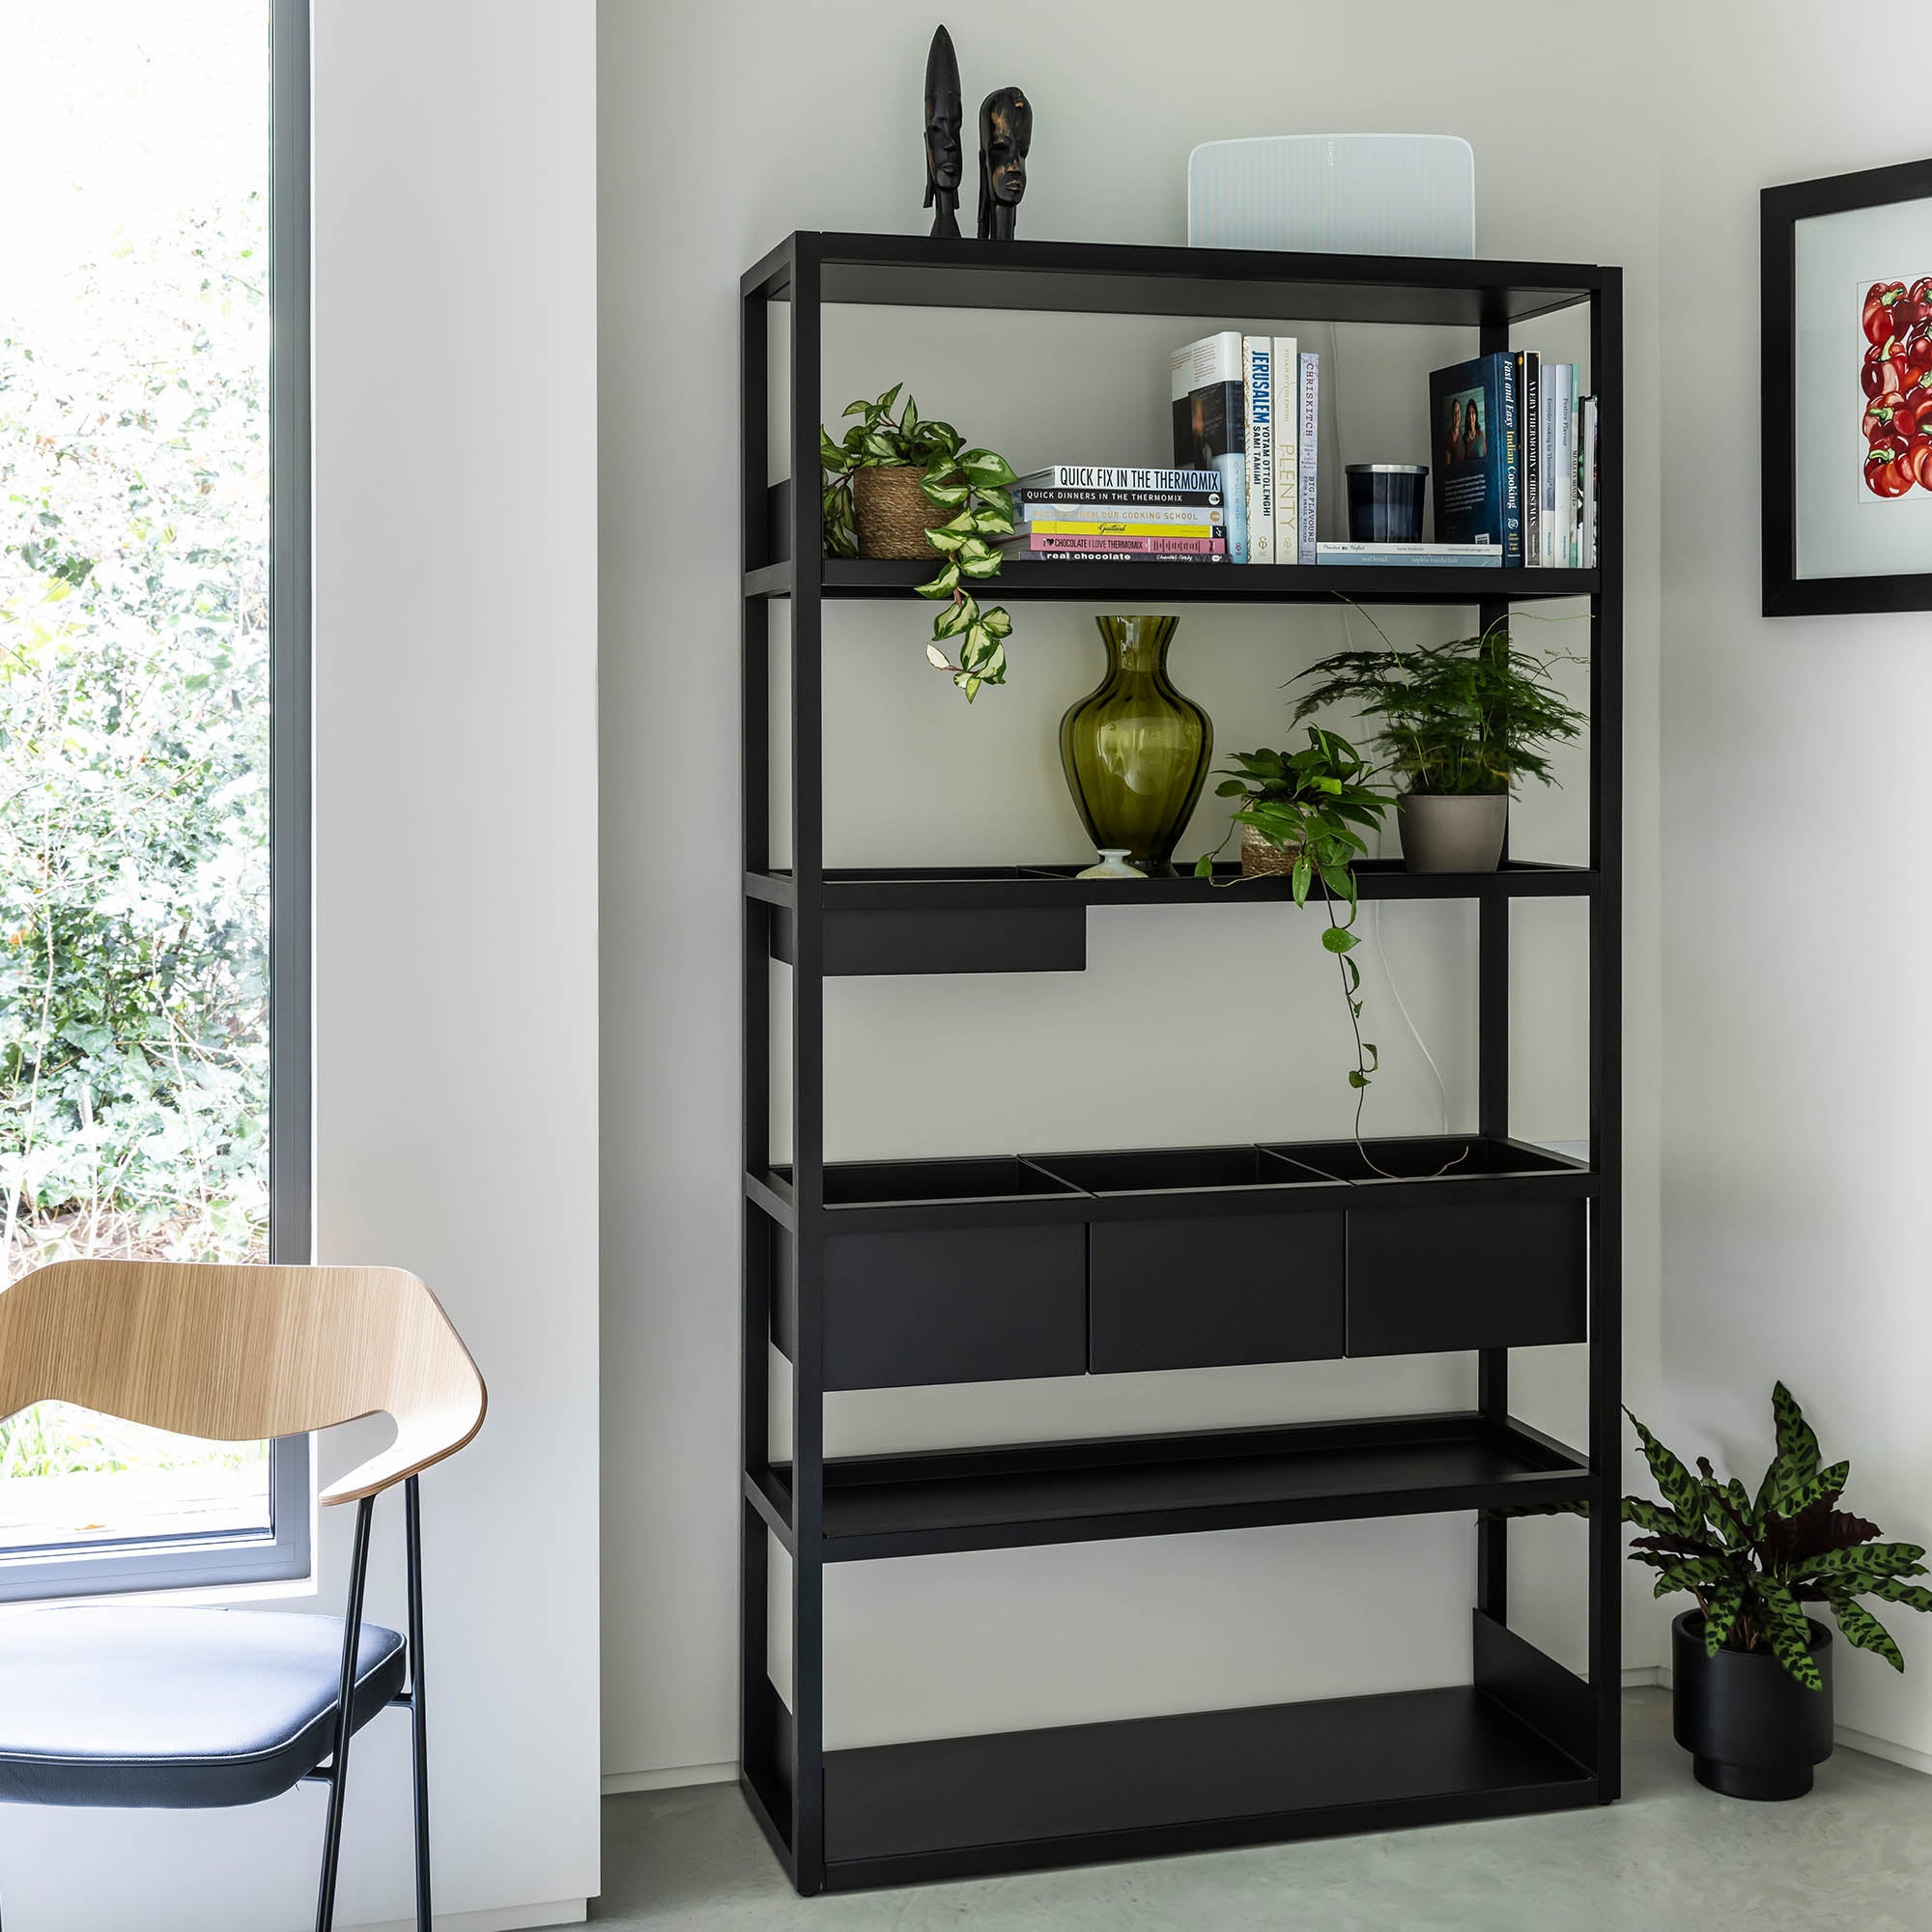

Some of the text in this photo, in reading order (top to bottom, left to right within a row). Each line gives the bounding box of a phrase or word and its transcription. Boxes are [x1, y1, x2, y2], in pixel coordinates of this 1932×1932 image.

[1252, 350, 1270, 423] JERUSALEM
[1305, 362, 1315, 437] CHRISKITCH
[1253, 425, 1262, 485] SAMI TAMIMI
[1504, 359, 1518, 509] Fast and Easy Indian Cooking
[1026, 491, 1055, 500] QUICK
[1057, 492, 1096, 500] DINNERS
[1060, 467, 1219, 491] QUICK FIX IN THE THERMOMIX
[1262, 425, 1271, 517] YOTAM OTTOLENGHI
[1278, 443, 1295, 531] PLENTY
[1073, 510, 1098, 519] FROM
[1122, 511, 1161, 520] COOKING
[1163, 512, 1199, 521] SCHOOL
[1092, 539, 1106, 549] LOVE
[1108, 540, 1144, 550] THERMOMIX
